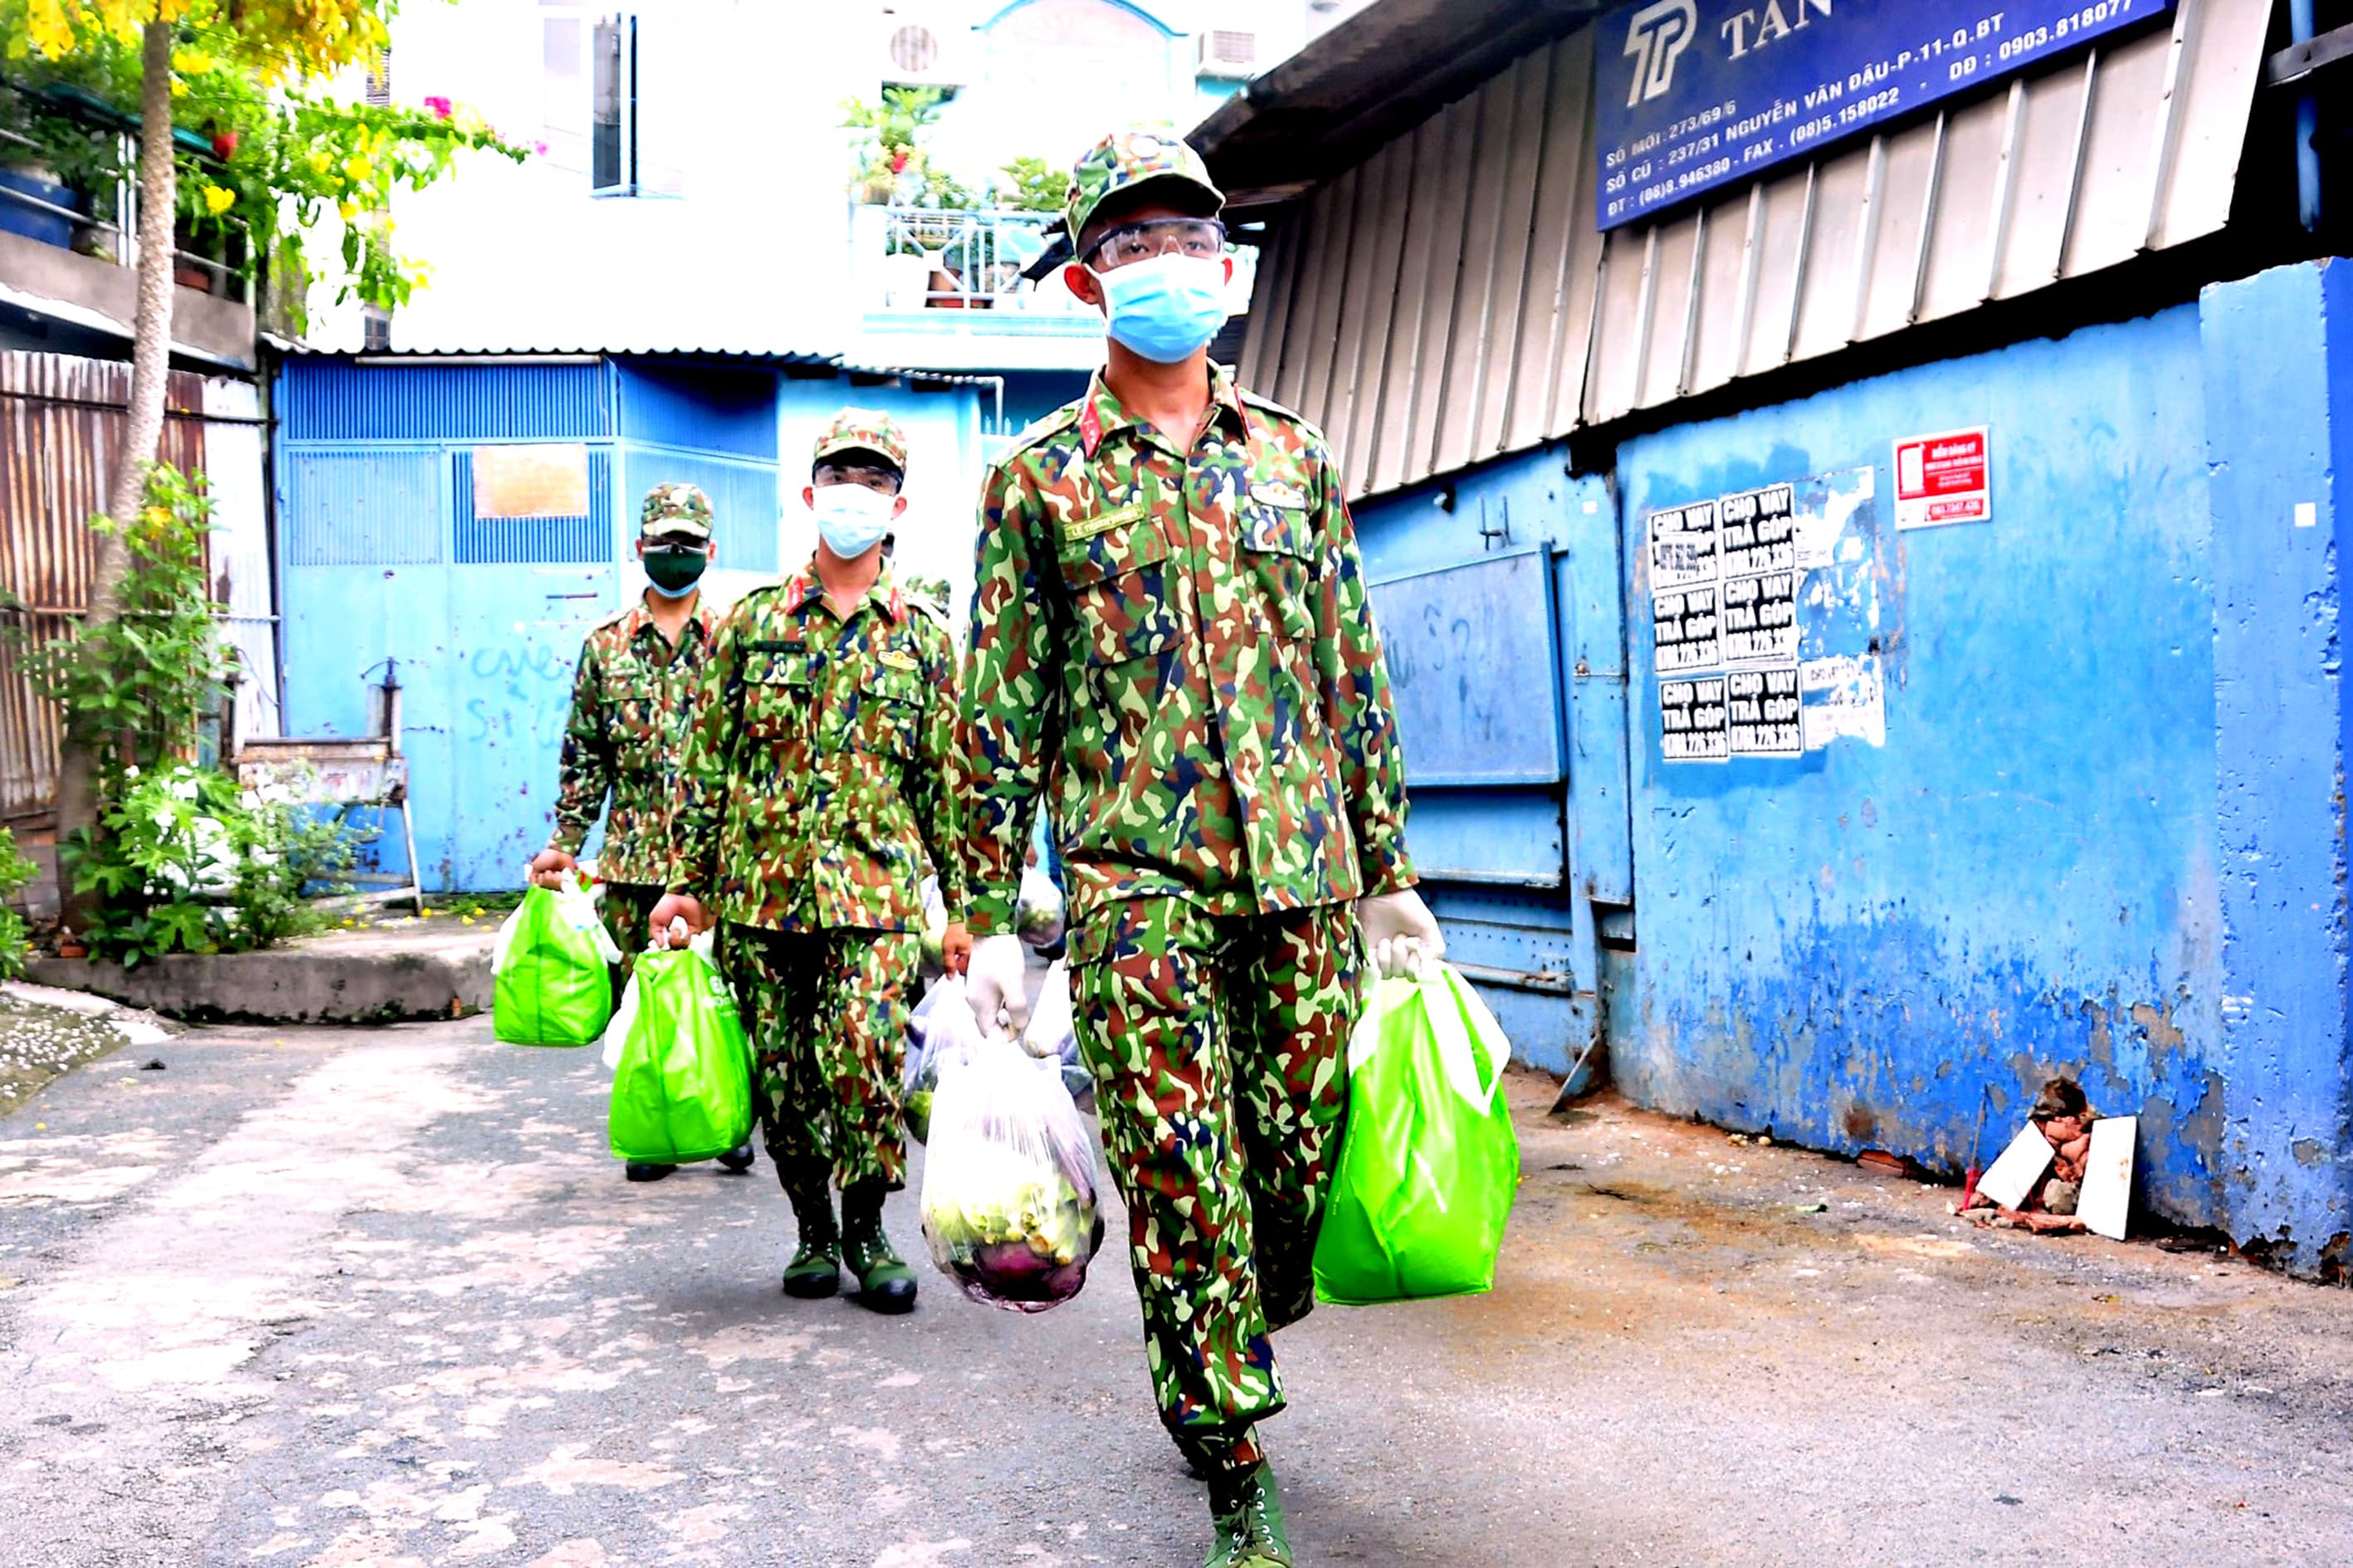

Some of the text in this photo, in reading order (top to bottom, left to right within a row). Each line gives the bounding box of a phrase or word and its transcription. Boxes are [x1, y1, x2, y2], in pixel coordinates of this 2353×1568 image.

[1668, 100, 1736, 139] 273/69/6
[1668, 133, 1719, 165] 237/31
[1726, 98, 1797, 141] NGUYỄN
[1804, 83, 1842, 109] VĂN
[1608, 198, 1626, 217] ĐT
[1744, 138, 1773, 163] FAX
[1789, 86, 1900, 147] (08)5.158022
[1653, 506, 1712, 535] CHO VAY
[1723, 489, 1789, 522] CHO VAY
[1723, 514, 1791, 548] TRẢ GÓP
[1654, 589, 1714, 618] CHO VAY
[1725, 574, 1791, 604] CHO VAY
[1654, 613, 1716, 642] TRẢ GÓP
[1726, 598, 1794, 631] TRẢ GÓP
[1662, 681, 1723, 706] CHO VAY
[1731, 672, 1764, 696] CHO
[1766, 671, 1795, 694] VAY
[1663, 703, 1725, 730] TRẢ GÓP
[1731, 692, 1798, 722] TRẢ GÓP
